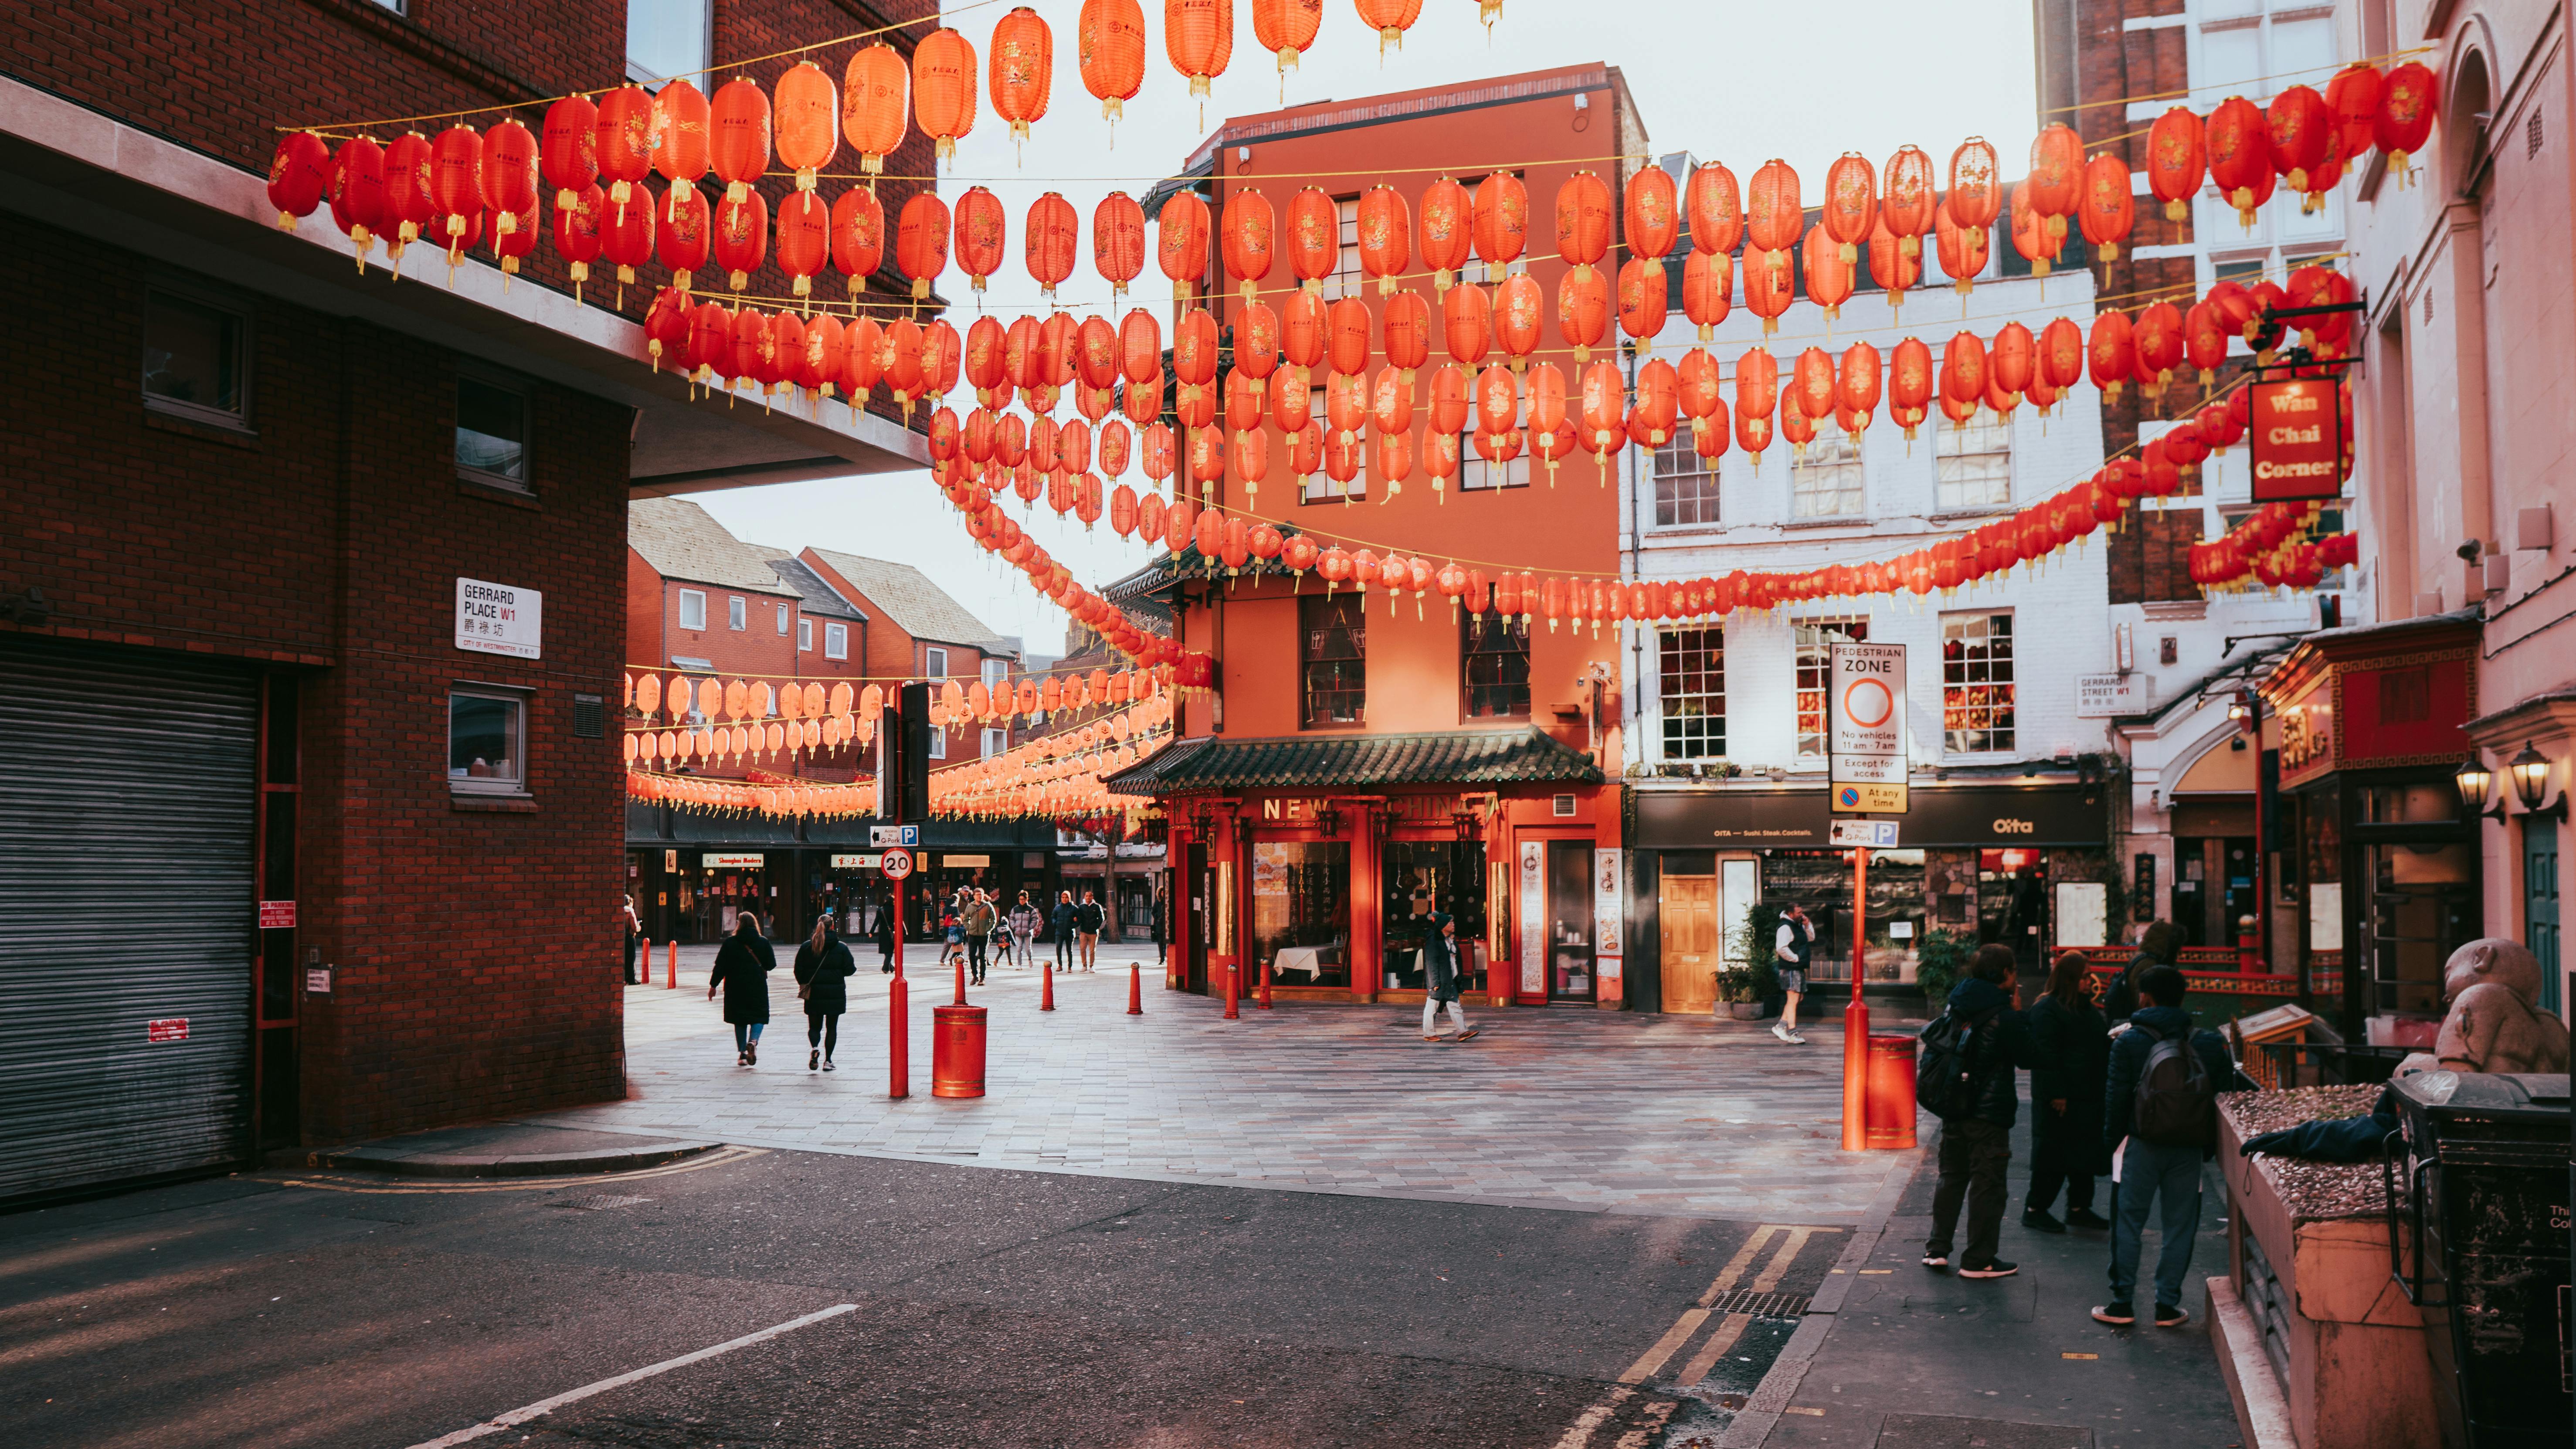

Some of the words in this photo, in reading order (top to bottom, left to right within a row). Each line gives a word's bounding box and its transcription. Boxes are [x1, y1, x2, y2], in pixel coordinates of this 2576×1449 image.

[855, 213, 869, 226] 福
[2270, 394, 2318, 413] Wan
[2268, 424, 2321, 445] Chai
[2256, 460, 2335, 479] Corner
[465, 584, 514, 605] GERRARD
[465, 601, 496, 618] PLACE
[500, 607, 516, 621] W1
[483, 642, 516, 653] WESTMINSTER
[1835, 648, 1901, 657] PEDESTRIAN
[1845, 660, 1892, 673] ZONE
[2081, 678, 2122, 687] GERRARD
[2082, 688, 2113, 697] STREET
[1859, 731, 1897, 740] vehicles
[1845, 759, 1877, 769] Except
[1880, 760, 1893, 768] for
[1882, 790, 1899, 798] any
[1265, 799, 1329, 819] NEW
[1387, 797, 1469, 818] CHINA
[1873, 799, 1894, 807] time
[1993, 818, 2033, 833] Oita
[904, 828, 914, 843] P
[1845, 833, 1872, 842] Q-Park
[1878, 825, 1893, 843] P
[886, 857, 908, 871] 20
[2549, 1205, 2570, 1216] Thi
[2550, 1218, 2572, 1228] Col
